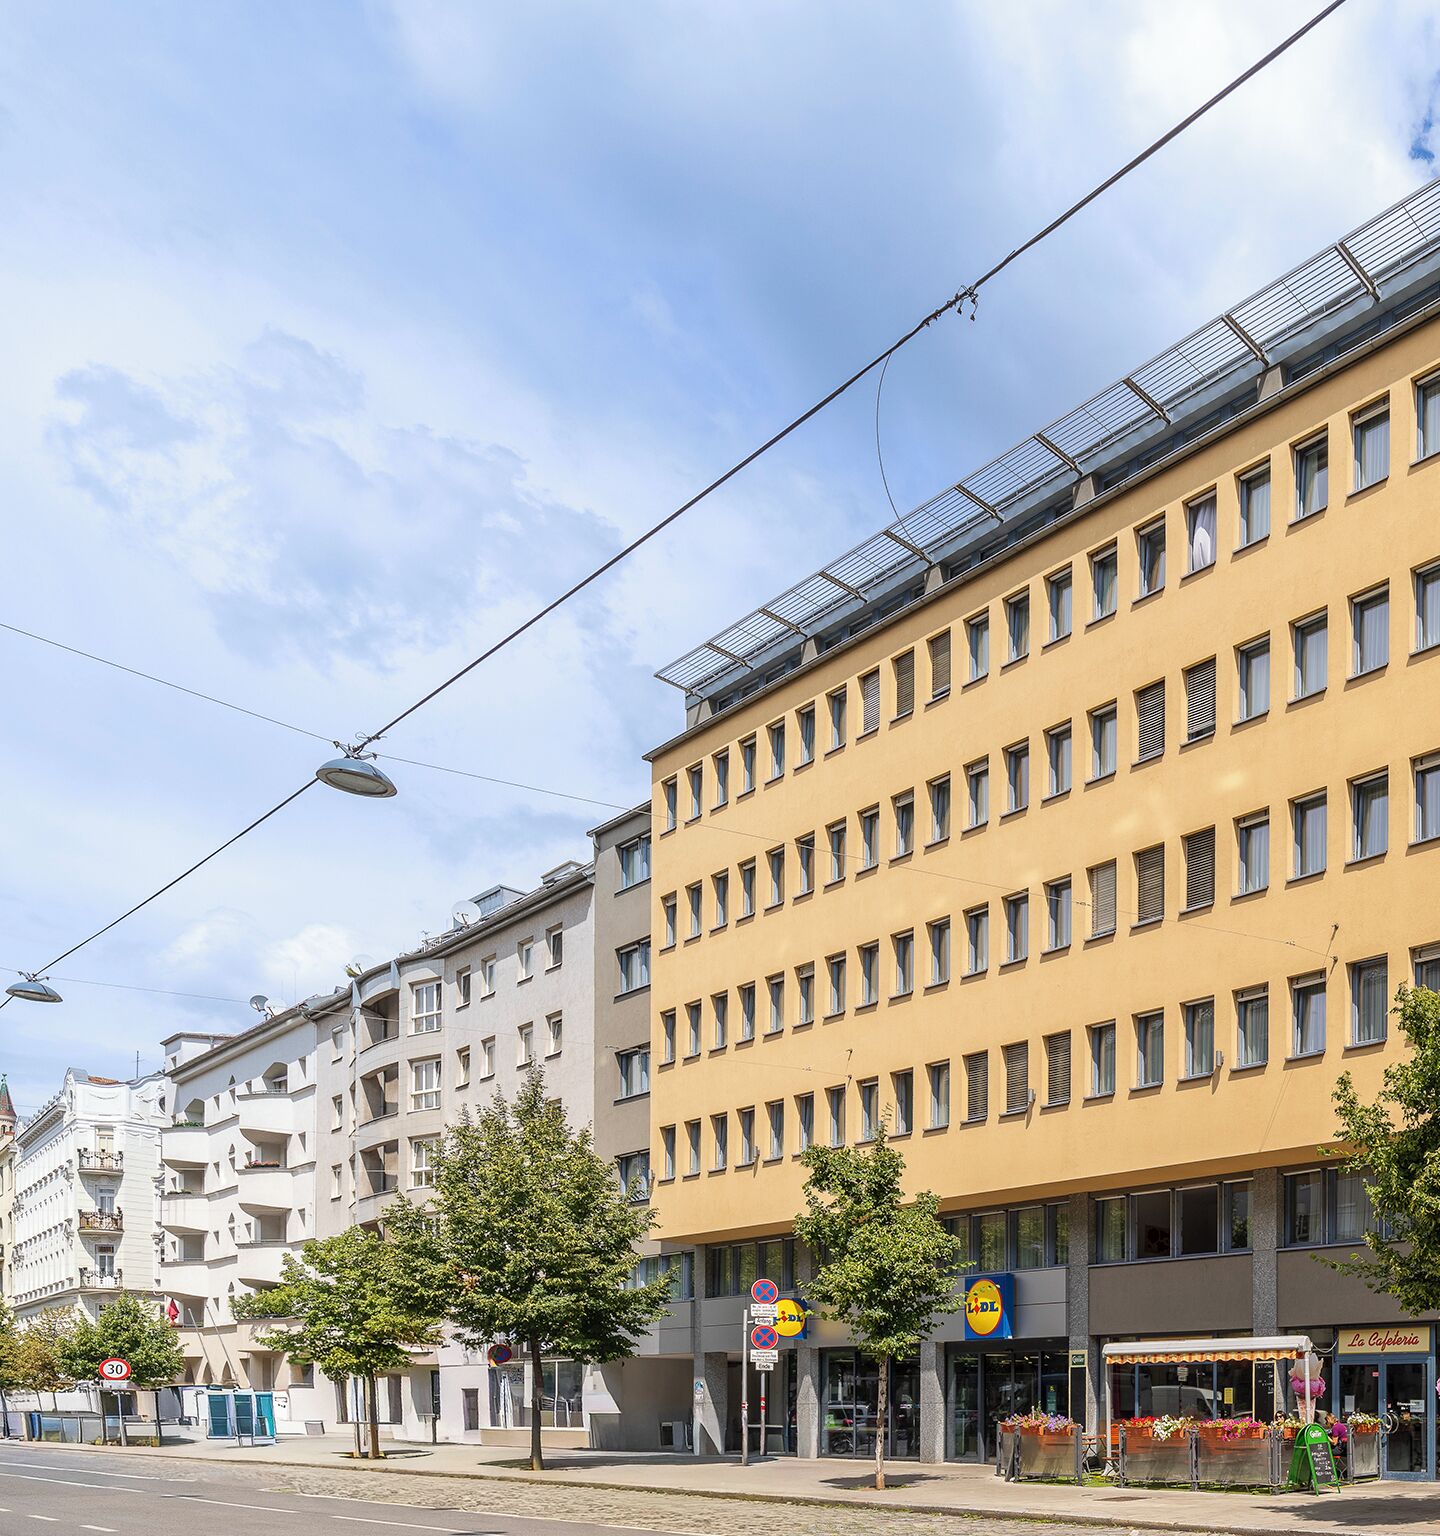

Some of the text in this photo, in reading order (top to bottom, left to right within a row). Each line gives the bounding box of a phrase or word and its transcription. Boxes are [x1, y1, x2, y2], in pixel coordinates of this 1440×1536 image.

[1347, 1330, 1420, 1352] La Cafeteria
[107, 1363, 123, 1375] 30
